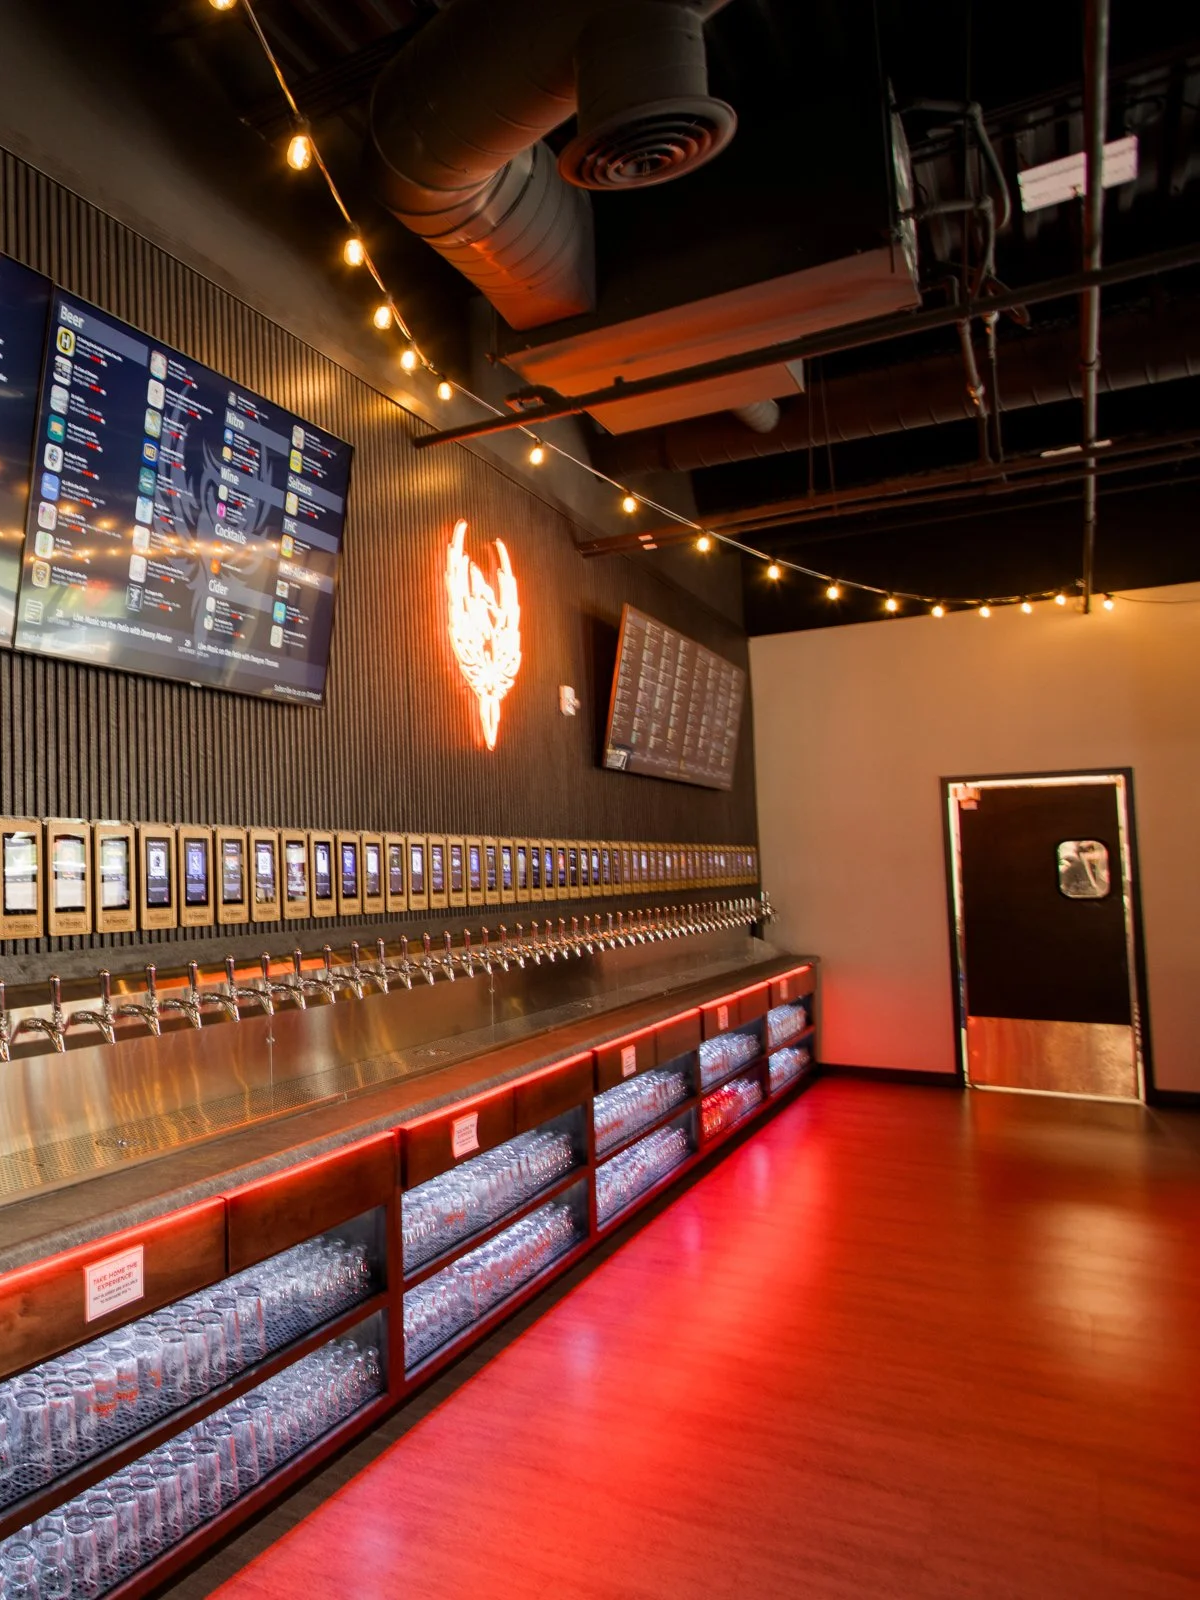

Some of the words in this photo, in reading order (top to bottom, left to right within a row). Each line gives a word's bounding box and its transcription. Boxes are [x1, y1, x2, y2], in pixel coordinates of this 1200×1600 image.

[59, 304, 84, 330] Beer
[60, 333, 69, 350] H
[225, 410, 245, 431] Nitro
[219, 465, 240, 486] Wine
[287, 474, 313, 497] Seltzers
[214, 522, 247, 545] Cocktails
[283, 518, 297, 534] THC
[207, 578, 228, 596] Cider
[84, 615, 99, 627] Music
[99, 618, 107, 628] on
[106, 620, 116, 630] the
[116, 622, 130, 633] Patio
[129, 625, 140, 636] with
[93, 1275, 107, 1284] TAKE
[108, 1267, 125, 1278] HOME
